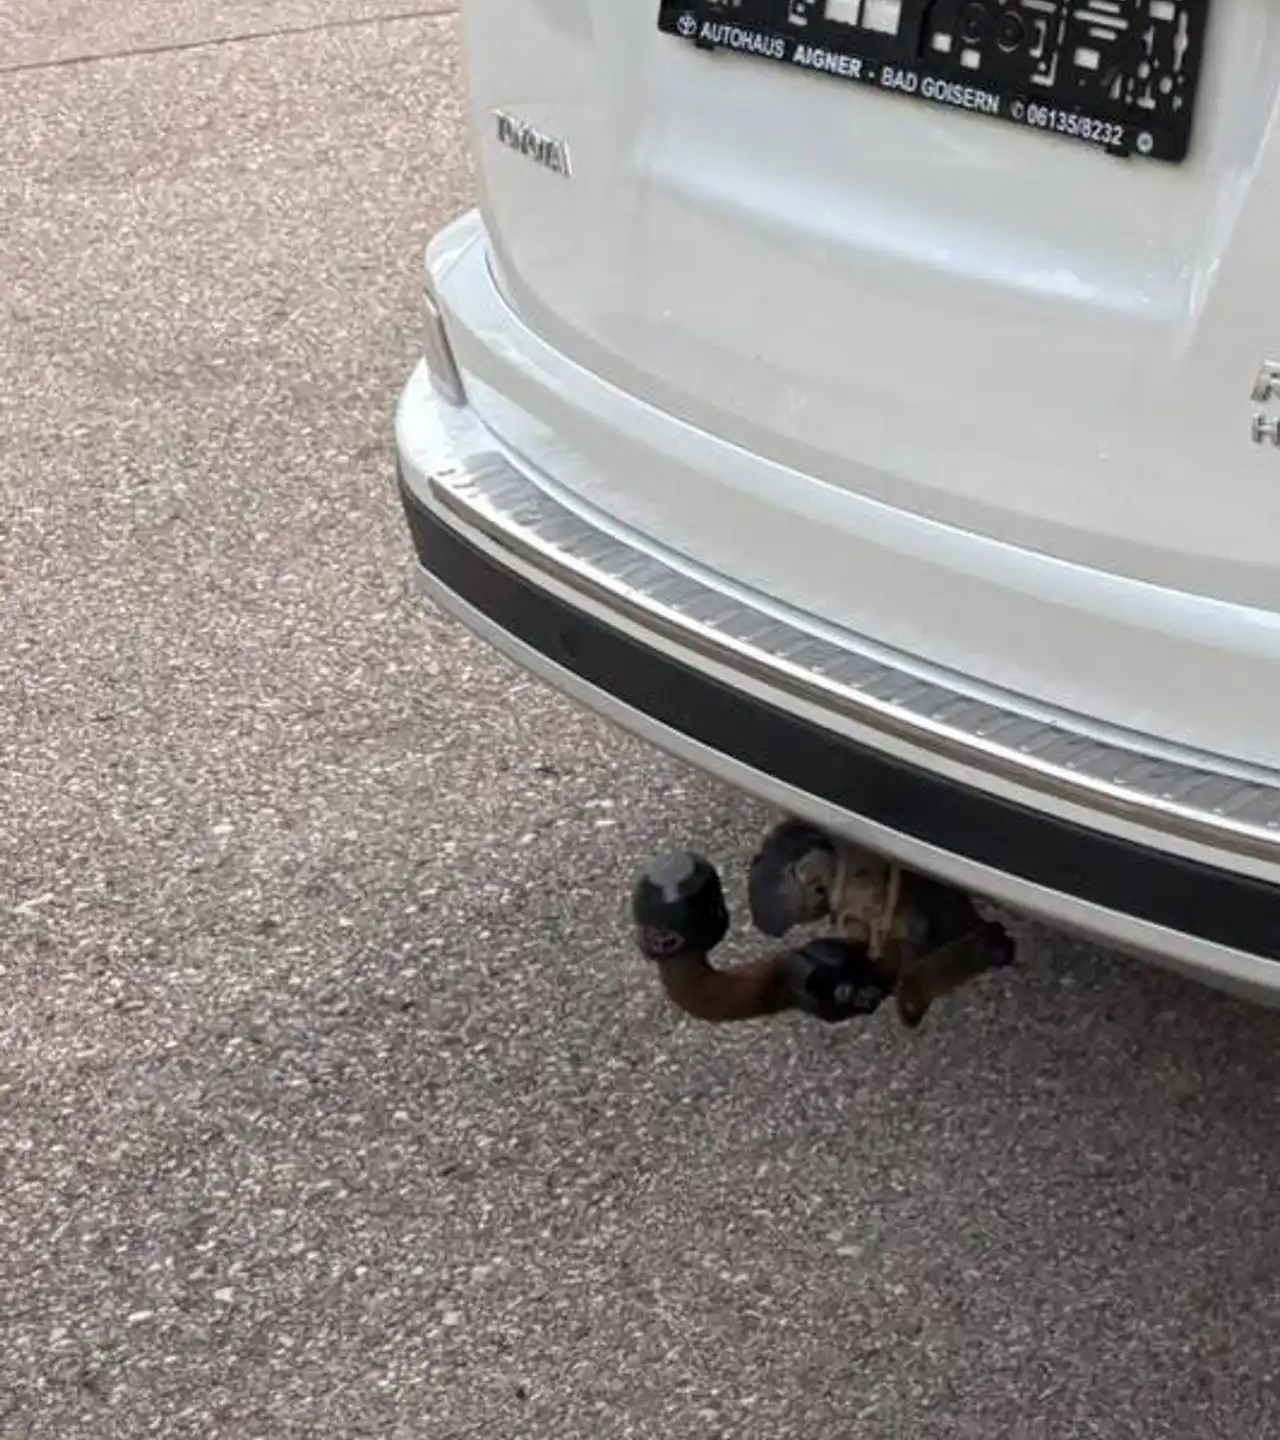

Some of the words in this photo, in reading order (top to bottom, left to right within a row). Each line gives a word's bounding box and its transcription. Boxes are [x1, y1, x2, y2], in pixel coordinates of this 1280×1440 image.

[700, 21, 785, 59] AUTOHAUS
[793, 44, 863, 79] AIGNER
[880, 66, 918, 94] BAD
[920, 77, 1000, 113] GOISERN
[1026, 103, 1125, 146] 06135/8232
